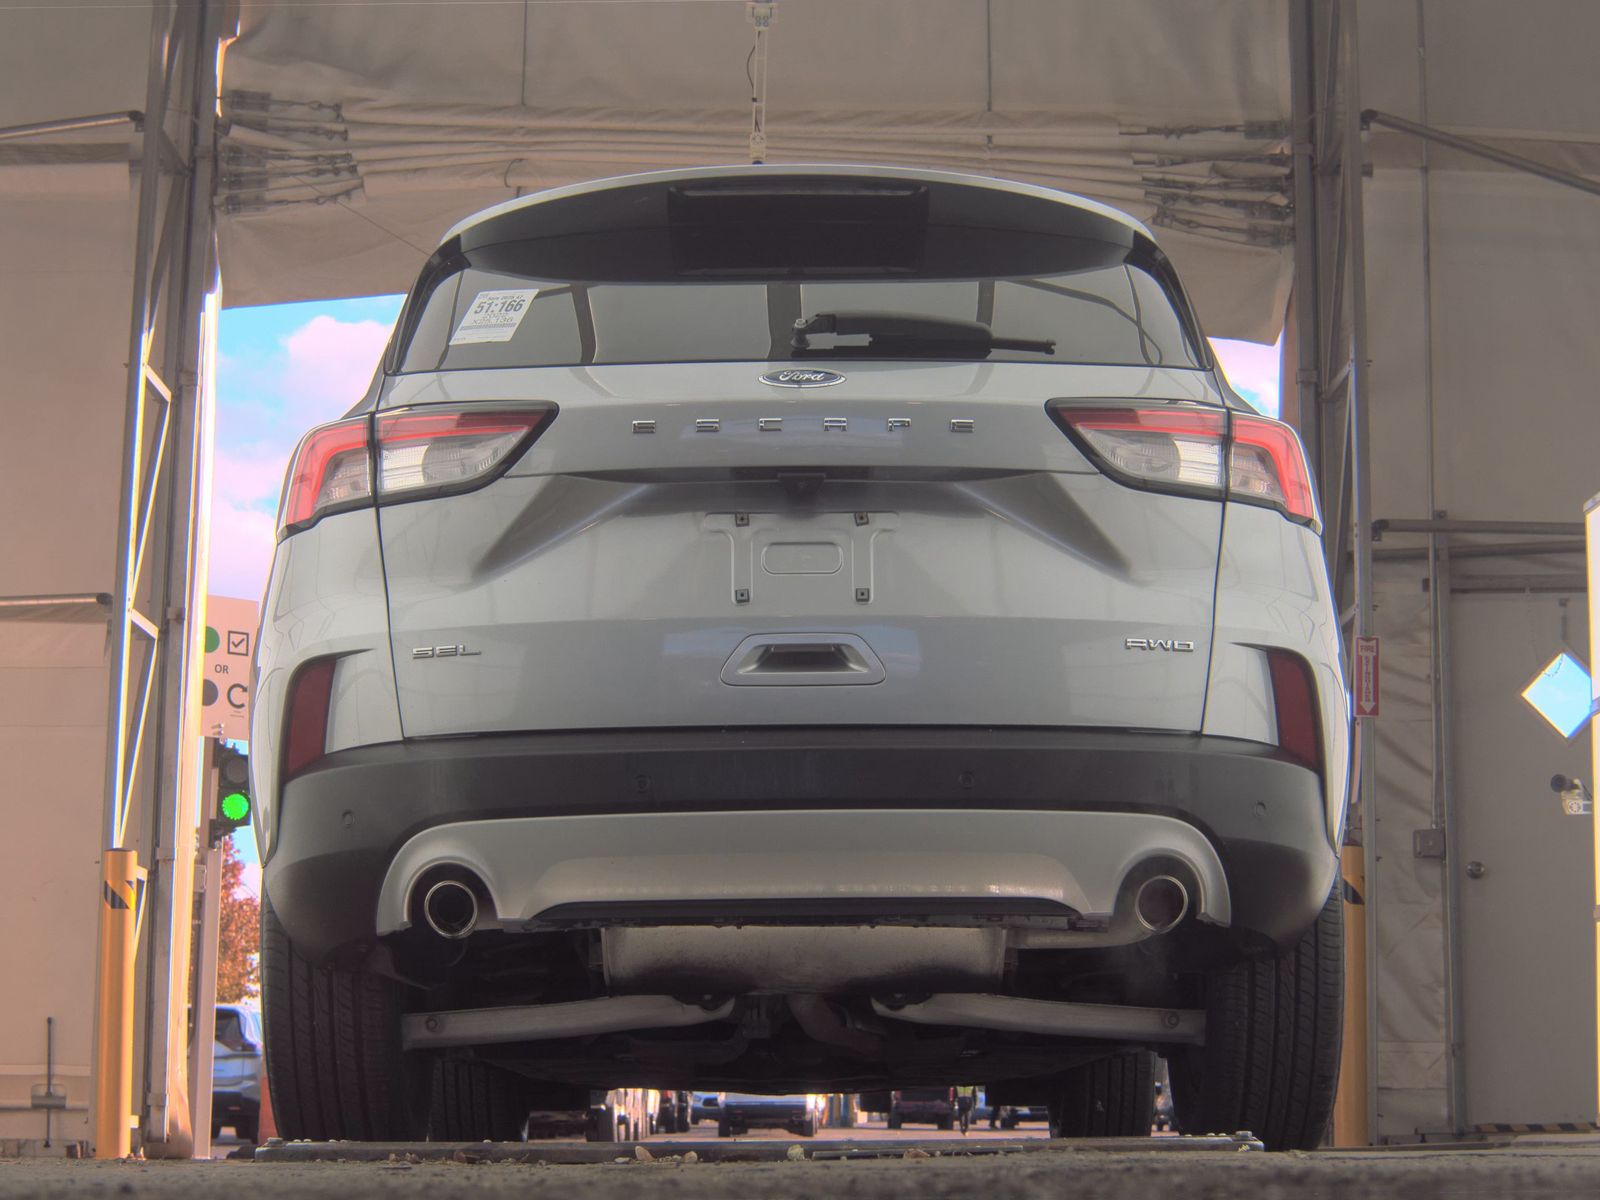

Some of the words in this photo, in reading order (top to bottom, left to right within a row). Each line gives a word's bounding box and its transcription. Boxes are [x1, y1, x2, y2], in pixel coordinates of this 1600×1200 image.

[474, 299, 526, 314] 51:166
[779, 370, 825, 381] Ford
[632, 417, 974, 434] ESCAPE
[412, 645, 482, 659] SEL
[1125, 638, 1194, 653] AWD
[214, 664, 229, 675] OR
